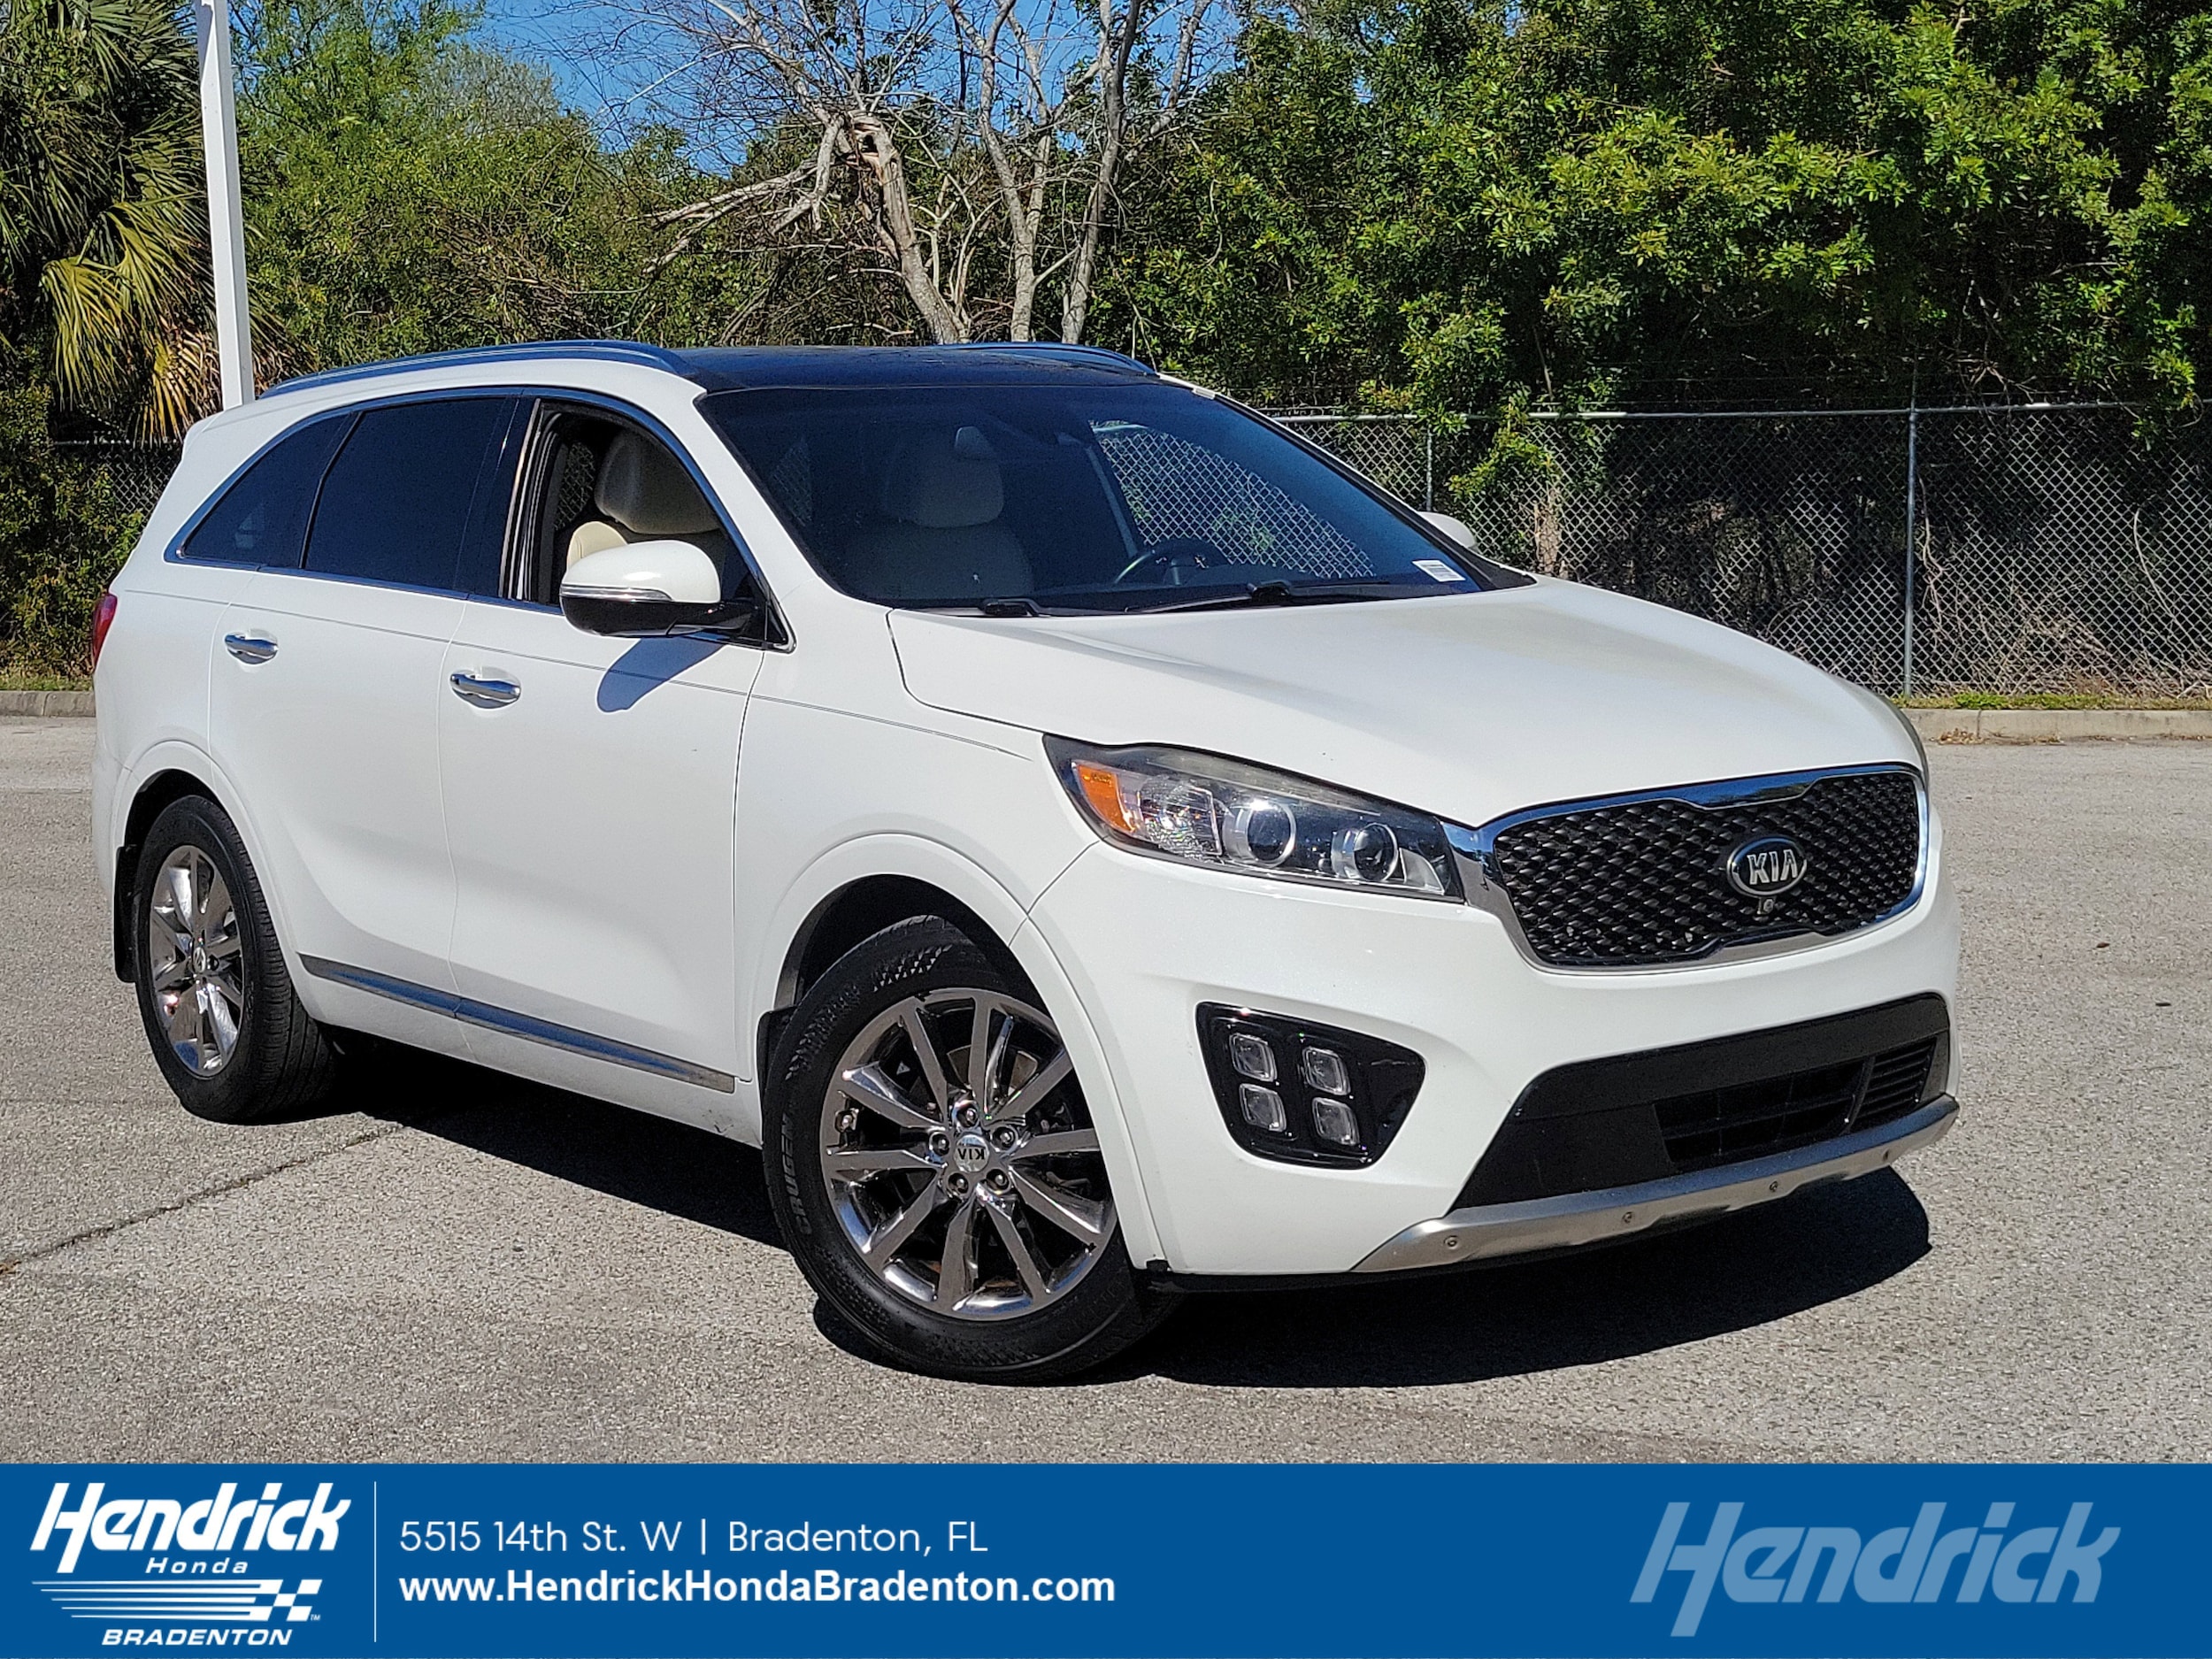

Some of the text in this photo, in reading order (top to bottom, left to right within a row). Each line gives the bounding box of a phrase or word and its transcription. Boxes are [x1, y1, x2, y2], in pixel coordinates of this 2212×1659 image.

[1747, 849, 1798, 885] KIA
[957, 1148, 985, 1160] KIA
[781, 1112, 812, 1235] CRUGEN
